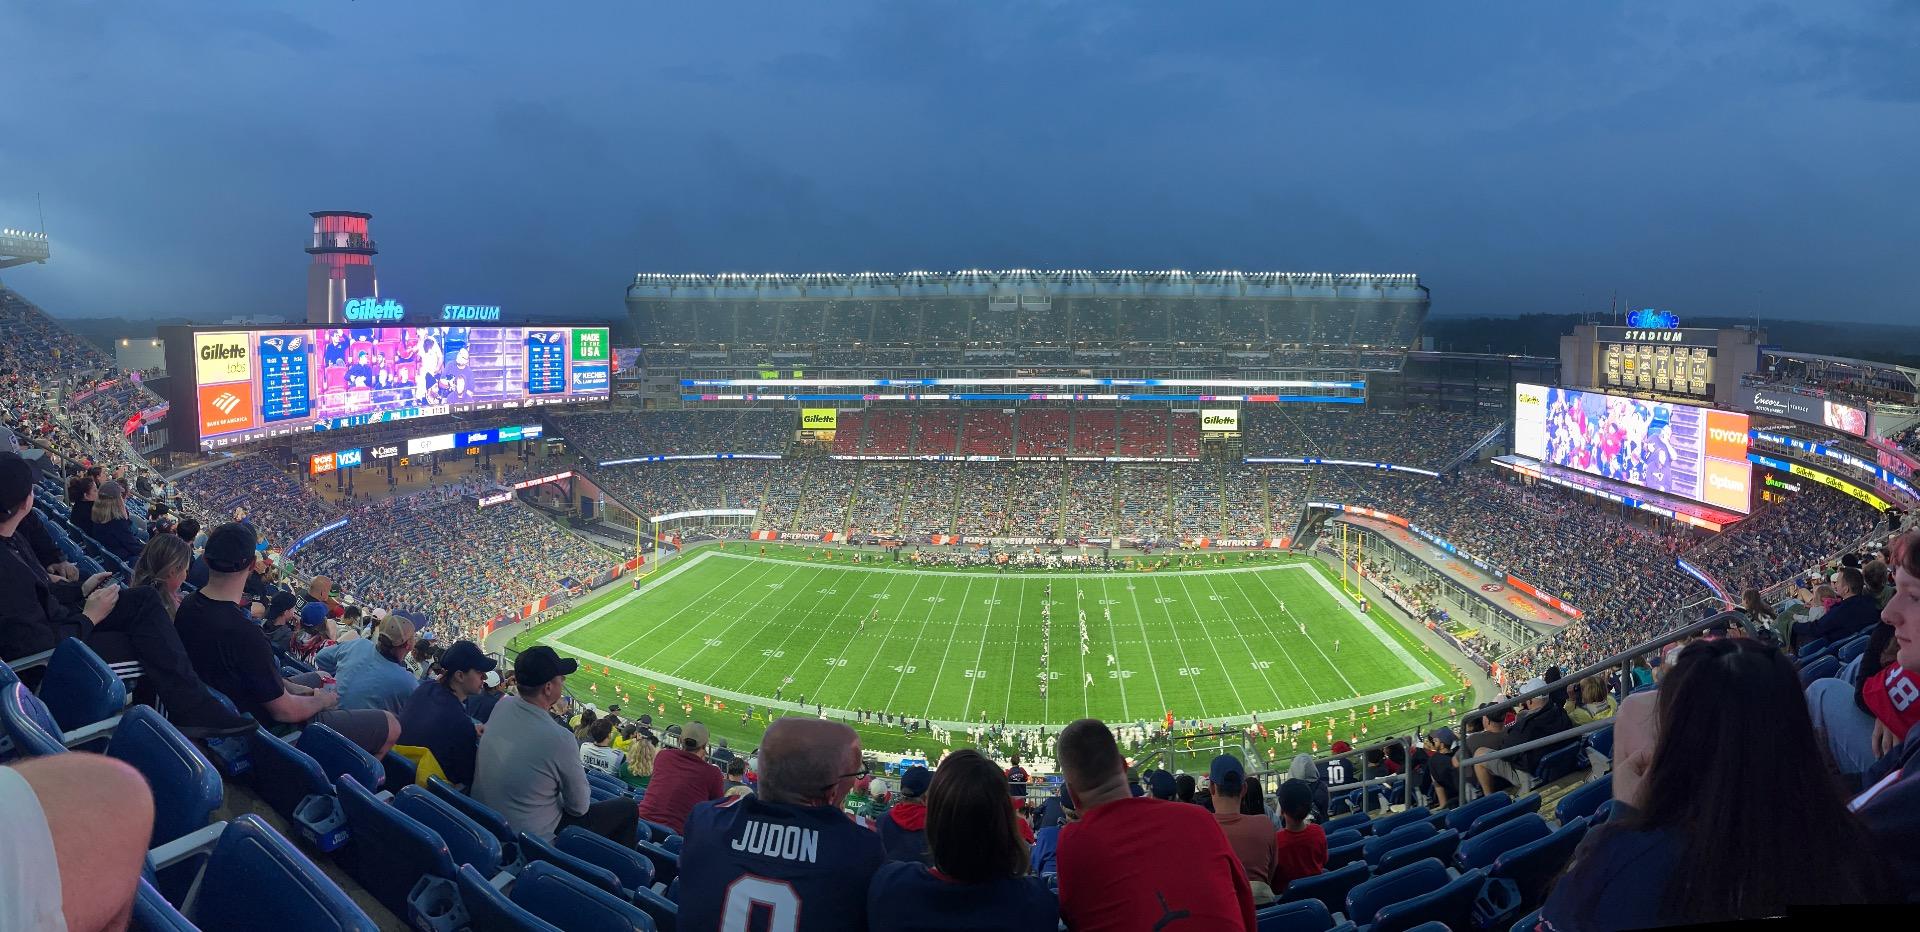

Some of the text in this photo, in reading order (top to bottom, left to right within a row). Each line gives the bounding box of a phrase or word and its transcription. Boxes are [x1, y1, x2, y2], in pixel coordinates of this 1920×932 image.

[345, 298, 500, 320] Gillette STADIUM
[1627, 308, 1680, 329] Gillette
[1625, 331, 1683, 341] STADIUM
[201, 344, 246, 360] Gillette
[581, 347, 600, 357] USA
[1754, 392, 1788, 408] Encore
[1204, 416, 1235, 424] Gillette
[1710, 428, 1748, 445] TOYOTA
[320, 455, 333, 463] CVS
[339, 451, 361, 465] VISA
[400, 458, 408, 466] 25
[315, 463, 334, 473] Health
[1709, 473, 1744, 492] Optum
[780, 532, 820, 541] PATRIOTS
[1216, 539, 1258, 547] PATRIOTS
[1535, 589, 1551, 602] Optum
[1560, 602, 1577, 616] Optum
[705, 639, 723, 647] 10
[763, 649, 785, 658] 20
[826, 658, 848, 667] 30
[1250, 661, 1269, 670] 10
[893, 665, 917, 674] 40
[964, 670, 986, 679] 50
[1108, 670, 1131, 679] 30
[1178, 667, 1201, 676] 20
[1327, 765, 1344, 785] 10
[731, 820, 819, 863] JUDON
